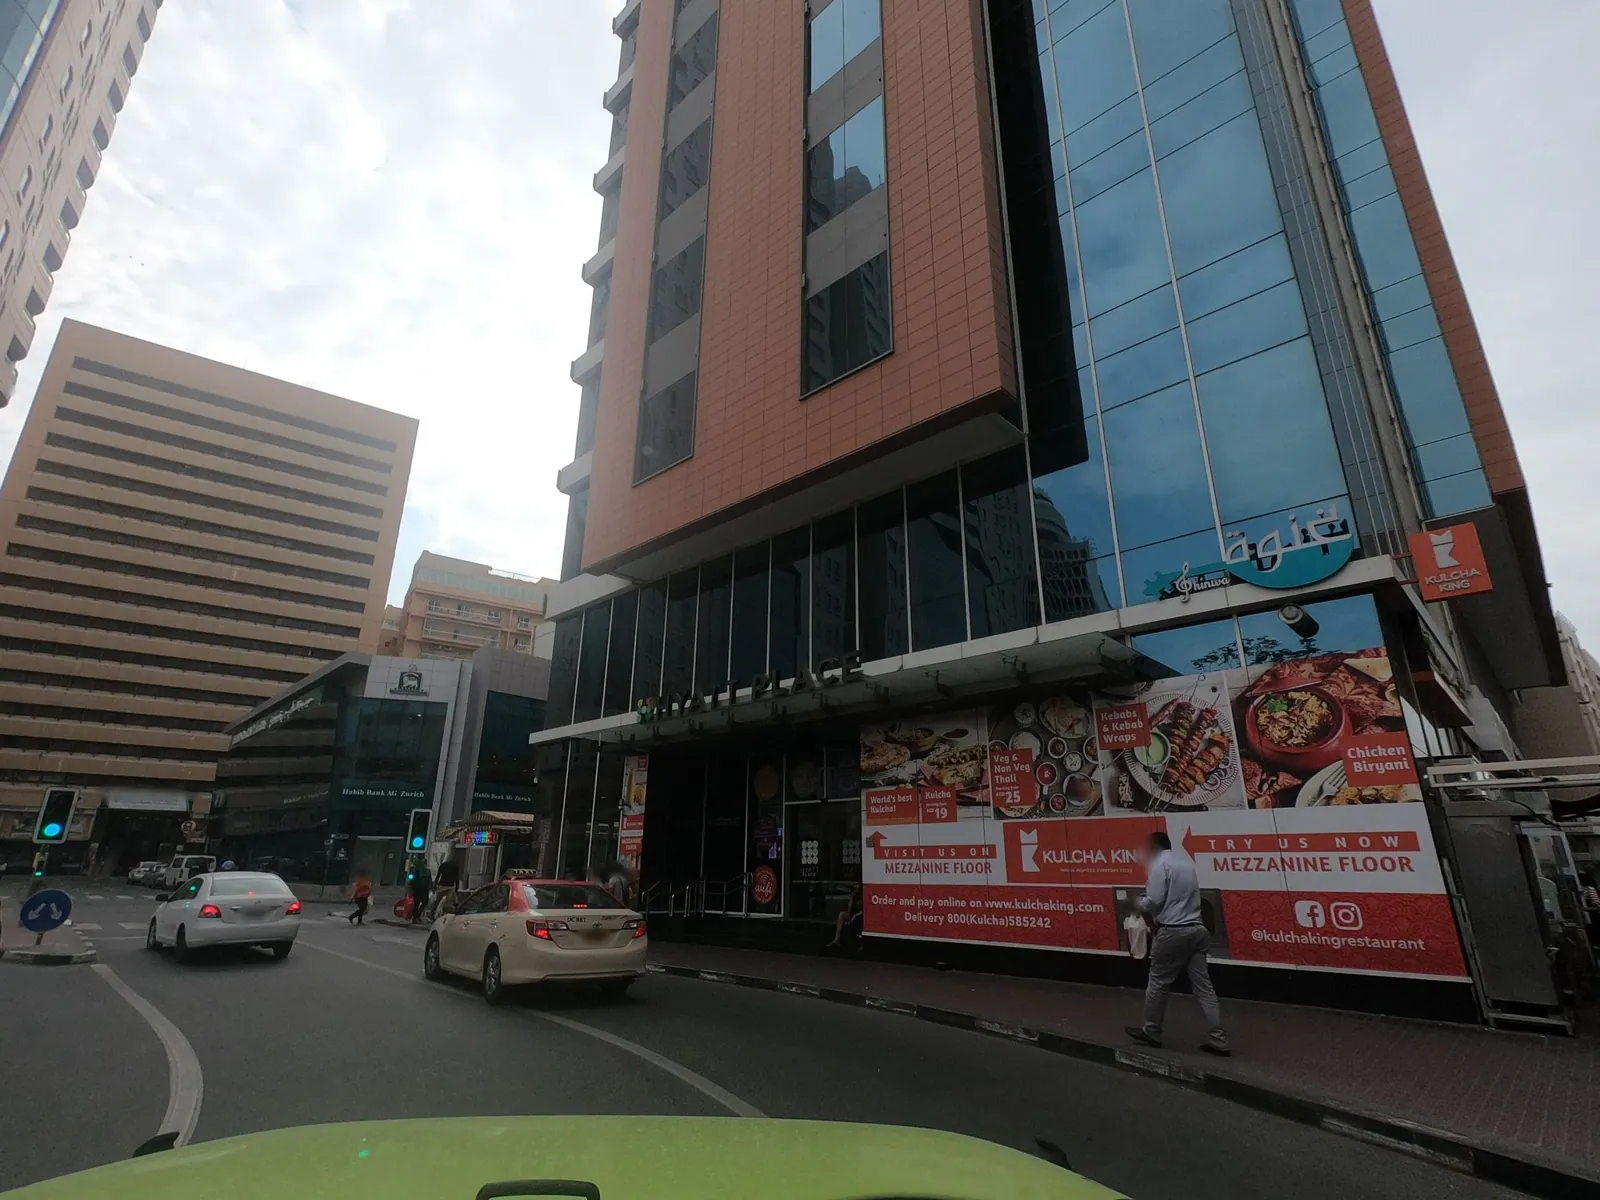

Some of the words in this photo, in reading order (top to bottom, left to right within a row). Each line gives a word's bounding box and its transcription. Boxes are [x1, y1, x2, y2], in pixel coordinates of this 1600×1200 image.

[1424, 567, 1481, 585] KULCHA
[1439, 579, 1471, 593] KING
[752, 652, 863, 701] PLACE
[1100, 709, 1138, 721] Kebabs
[1102, 724, 1110, 733] &
[1111, 718, 1143, 732] Kebab
[1103, 733, 1137, 744] Wraps
[993, 754, 1010, 764] Veg
[1011, 753, 1019, 762] &
[1346, 745, 1407, 759] Chicken
[994, 764, 1012, 774] Non
[1013, 762, 1031, 773] Veg
[1352, 757, 1410, 774] Biryani
[994, 773, 1017, 784] Thali
[341, 788, 365, 796] Habib
[366, 788, 385, 797] Bank
[386, 789, 398, 797] AG
[399, 790, 425, 798] Zurich
[870, 794, 896, 804] World's
[897, 794, 913, 803] best
[925, 790, 952, 800] Kulcha
[1005, 790, 1021, 804] 25
[870, 804, 897, 814] Kulcha!
[934, 807, 948, 820] 19
[1208, 838, 1253, 850] TRY
[1278, 837, 1309, 849] US
[1335, 835, 1400, 849] NOW
[883, 848, 925, 857] VISIT
[938, 847, 956, 857] US
[970, 847, 989, 856] ON
[1042, 848, 1108, 864] KULCHA
[1111, 848, 1139, 864] KIN
[885, 861, 950, 874] MEZZANINE
[953, 861, 993, 874] FLOOR
[1213, 856, 1333, 872] MEZZANINE
[1338, 856, 1416, 873] FLOOR
[871, 895, 897, 906] Order
[899, 895, 916, 907] and
[917, 898, 935, 909] pay
[938, 896, 968, 908] online
[969, 899, 983, 908] on
[985, 897, 1105, 915] www.kulchaking.com
[904, 911, 945, 924] Delivery
[947, 913, 1052, 929] 800(Kulcha)585242
[1251, 929, 1426, 951] @kulchakingrestaurant
